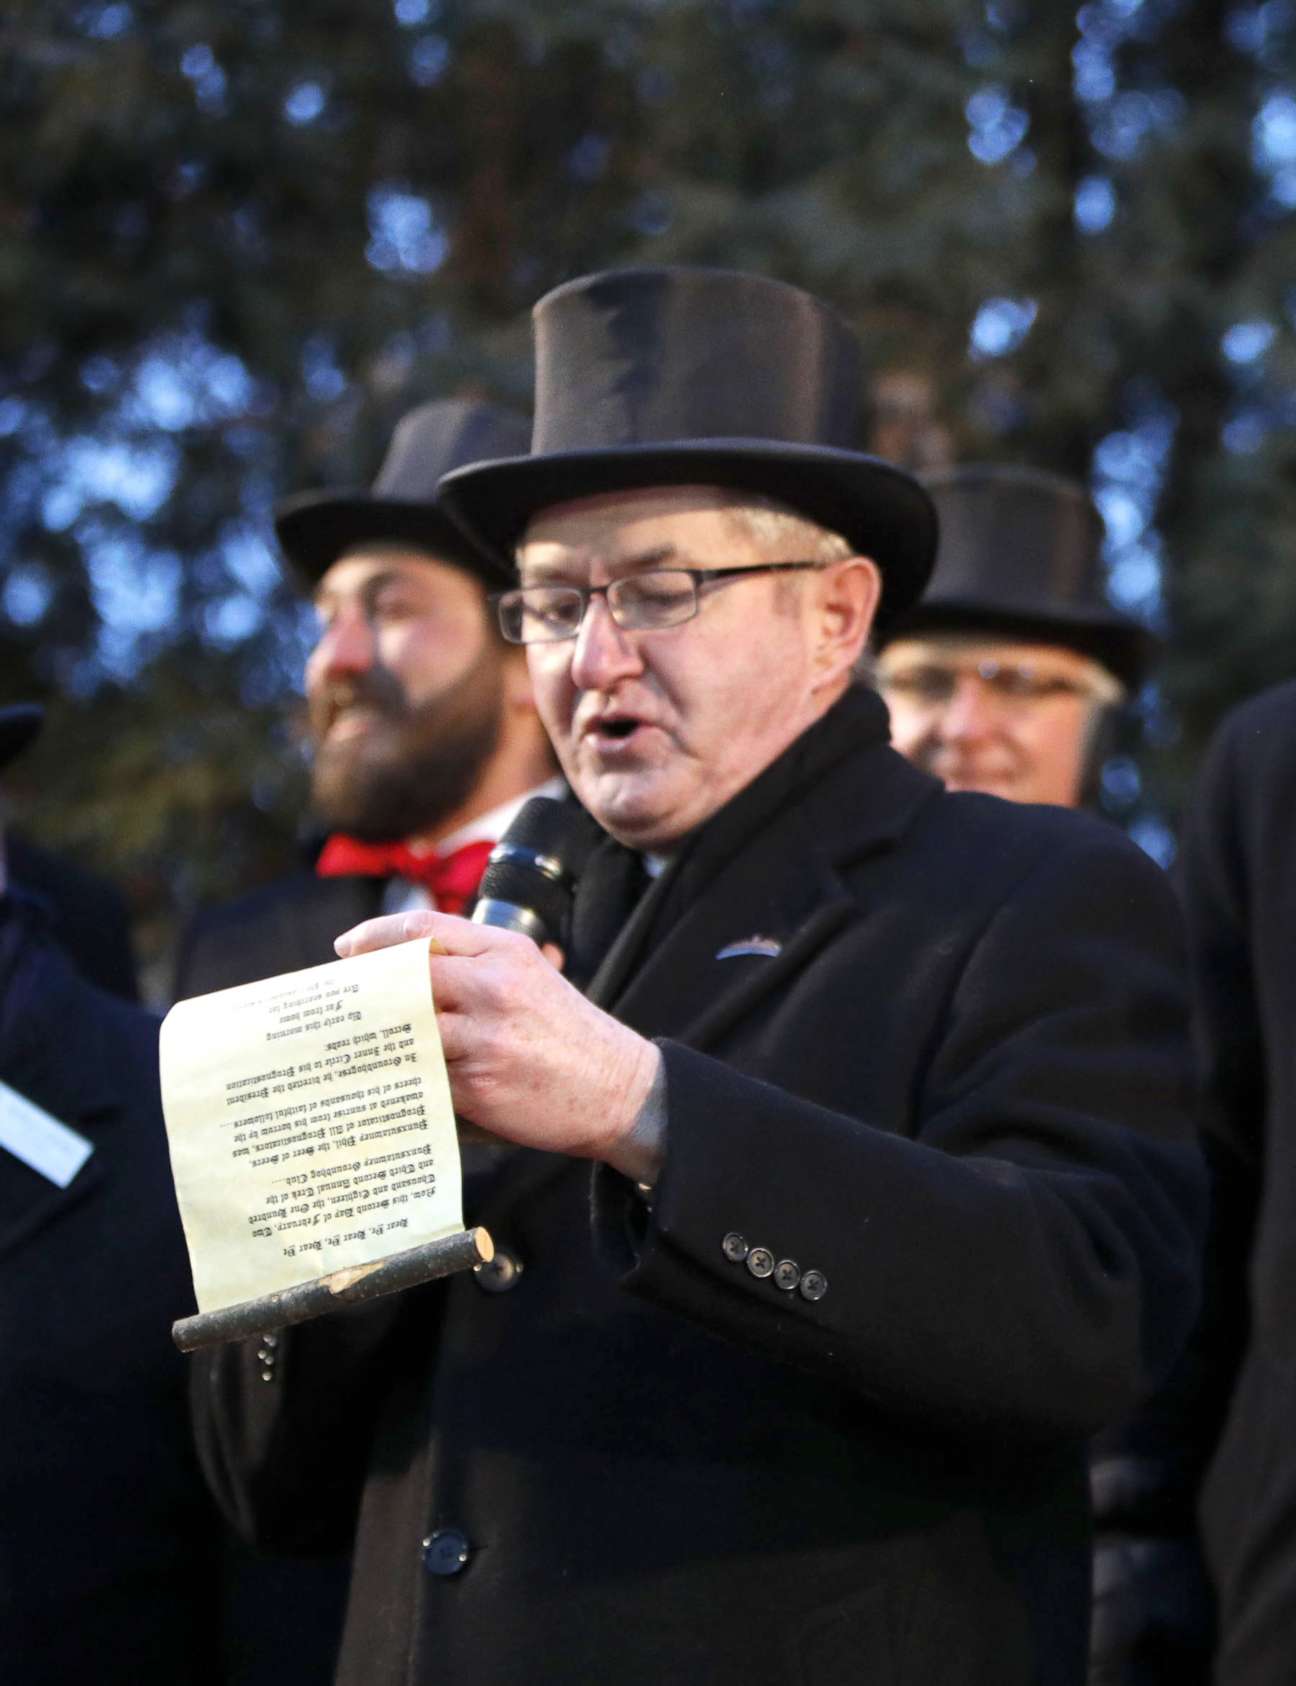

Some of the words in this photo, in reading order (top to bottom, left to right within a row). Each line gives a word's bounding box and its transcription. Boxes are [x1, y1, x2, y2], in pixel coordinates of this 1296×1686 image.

[302, 1006, 324, 1018] from
[324, 999, 344, 1013] Far
[304, 1020, 323, 1033] this
[322, 1014, 346, 1028] early
[265, 1025, 304, 1042] morning
[351, 1031, 378, 1046] which
[382, 1041, 397, 1054] the
[397, 1037, 415, 1050] and
[353, 1045, 381, 1060] Inner
[403, 1052, 418, 1064] In
[297, 1061, 313, 1073] his
[312, 1059, 324, 1070] to
[323, 1053, 352, 1068] Circle
[225, 1065, 296, 1091] Prognostication
[286, 1075, 322, 1092] directed
[322, 1071, 334, 1083] he
[393, 1076, 423, 1090] cheers
[271, 1083, 286, 1095] the
[366, 1085, 382, 1097] his
[382, 1083, 393, 1095] of
[225, 1086, 270, 1107] President
[319, 1089, 366, 1108] thousands
[379, 1091, 424, 1109] awakened
[273, 1103, 308, 1121] faithful
[308, 1101, 318, 1113] of
[332, 1104, 368, 1119] sunrise
[368, 1101, 379, 1112] at
[309, 1112, 332, 1124] from
[357, 1103, 427, 1128] Prognosticator
[293, 1117, 309, 1129] his
[345, 1121, 356, 1133] of
[248, 1129, 260, 1140] by
[328, 1124, 345, 1137] All
[358, 1117, 429, 1143] Punxsutawney
[233, 1132, 248, 1144] the
[231, 1146, 251, 1159] was
[292, 1145, 316, 1158] Seer
[316, 1142, 332, 1153] the
[281, 1151, 291, 1163] of
[363, 1143, 432, 1167] Punxsutawney
[309, 1160, 362, 1180] Groundhog
[388, 1163, 417, 1178] Third
[417, 1158, 435, 1171] and
[352, 1169, 388, 1186] Second
[390, 1173, 436, 1193] Thousand
[316, 1178, 352, 1195] Annual
[371, 1184, 389, 1197] and
[265, 1194, 280, 1206] the
[280, 1192, 290, 1204] of
[290, 1186, 315, 1201] Trek
[391, 1193, 409, 1206] this
[289, 1202, 311, 1214] One
[311, 1198, 326, 1210] the
[355, 1198, 391, 1215] Second
[247, 1207, 288, 1225] Hundred
[322, 1212, 333, 1224] of
[334, 1206, 355, 1219] Day
[385, 1217, 409, 1231] Hear
[251, 1226, 274, 1238] Two
[343, 1229, 367, 1242] Hear
[282, 1244, 297, 1258] Ye
[298, 1239, 324, 1253] Hear
